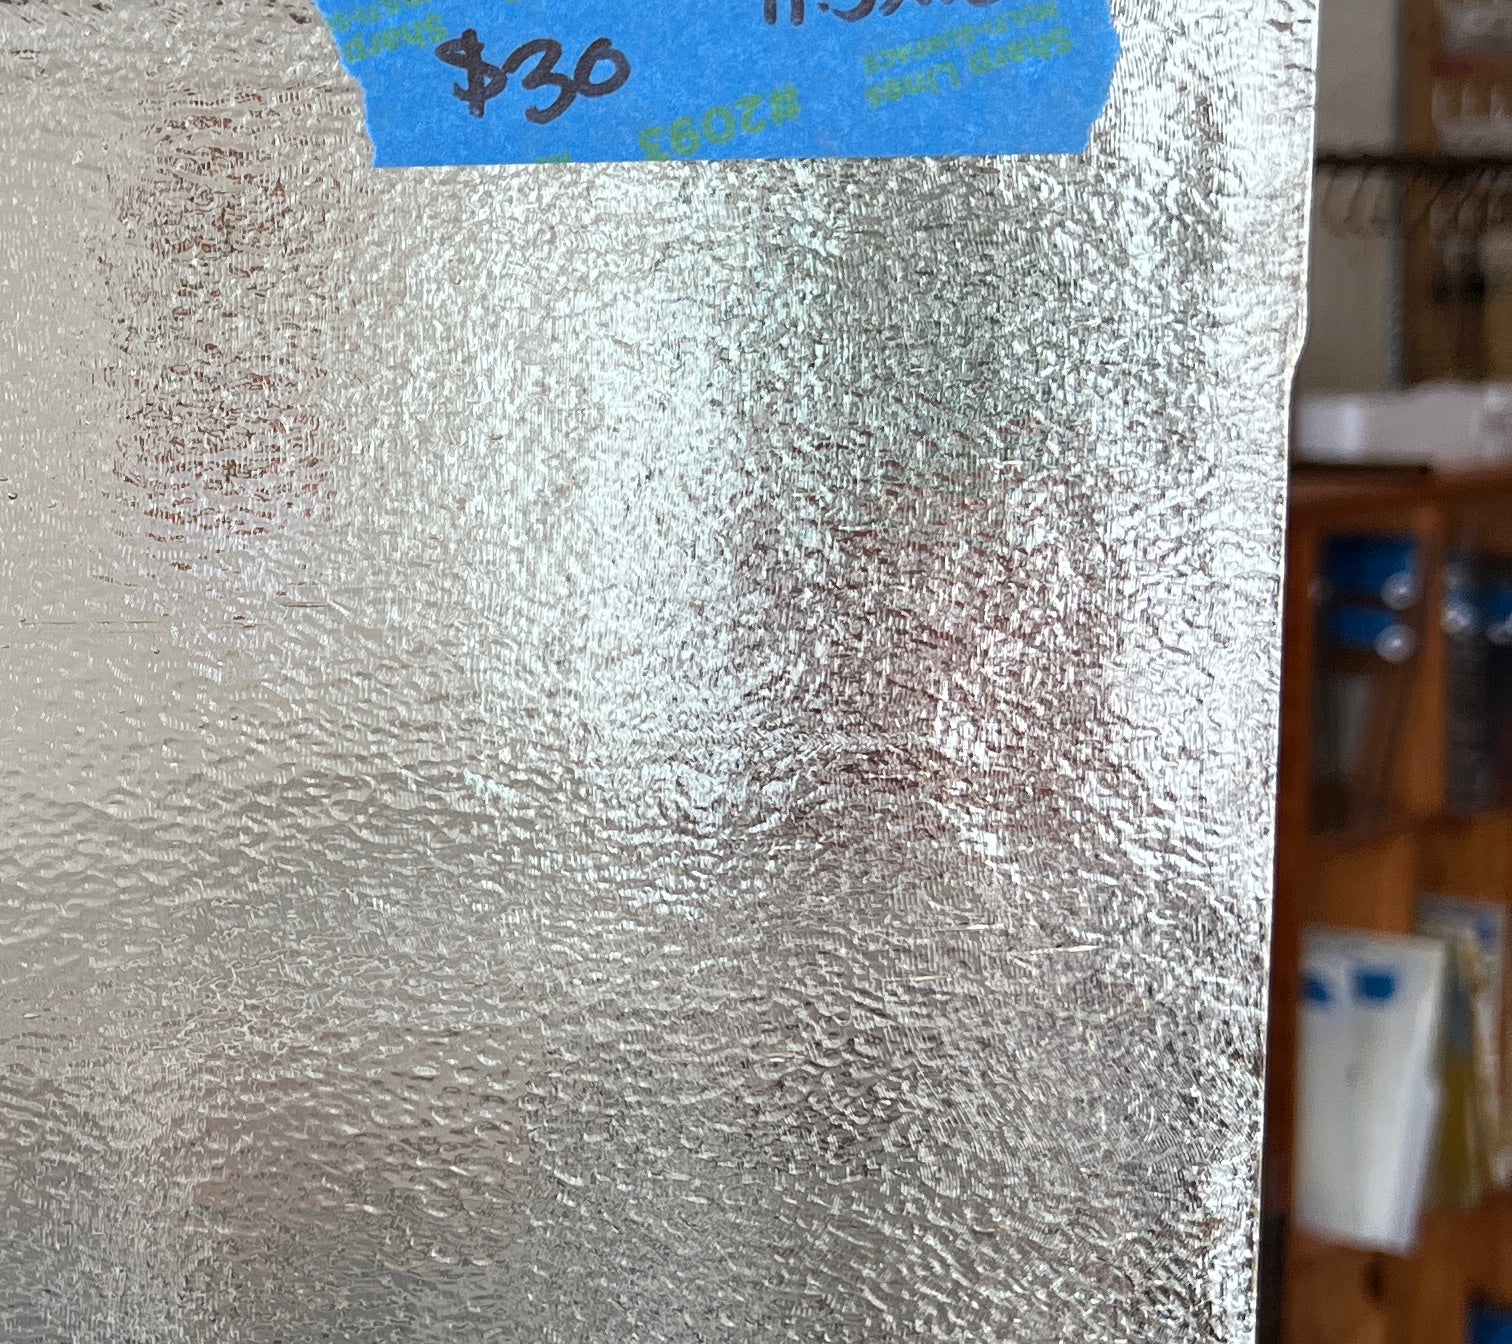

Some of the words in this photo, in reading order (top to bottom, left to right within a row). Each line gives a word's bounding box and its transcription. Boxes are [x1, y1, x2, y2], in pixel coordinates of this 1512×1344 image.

[343, 14, 448, 64] Sharp
[969, 27, 1073, 75] Sharp
[434, 28, 631, 125] $30
[864, 62, 960, 108] Lines
[639, 83, 801, 162] #2093
